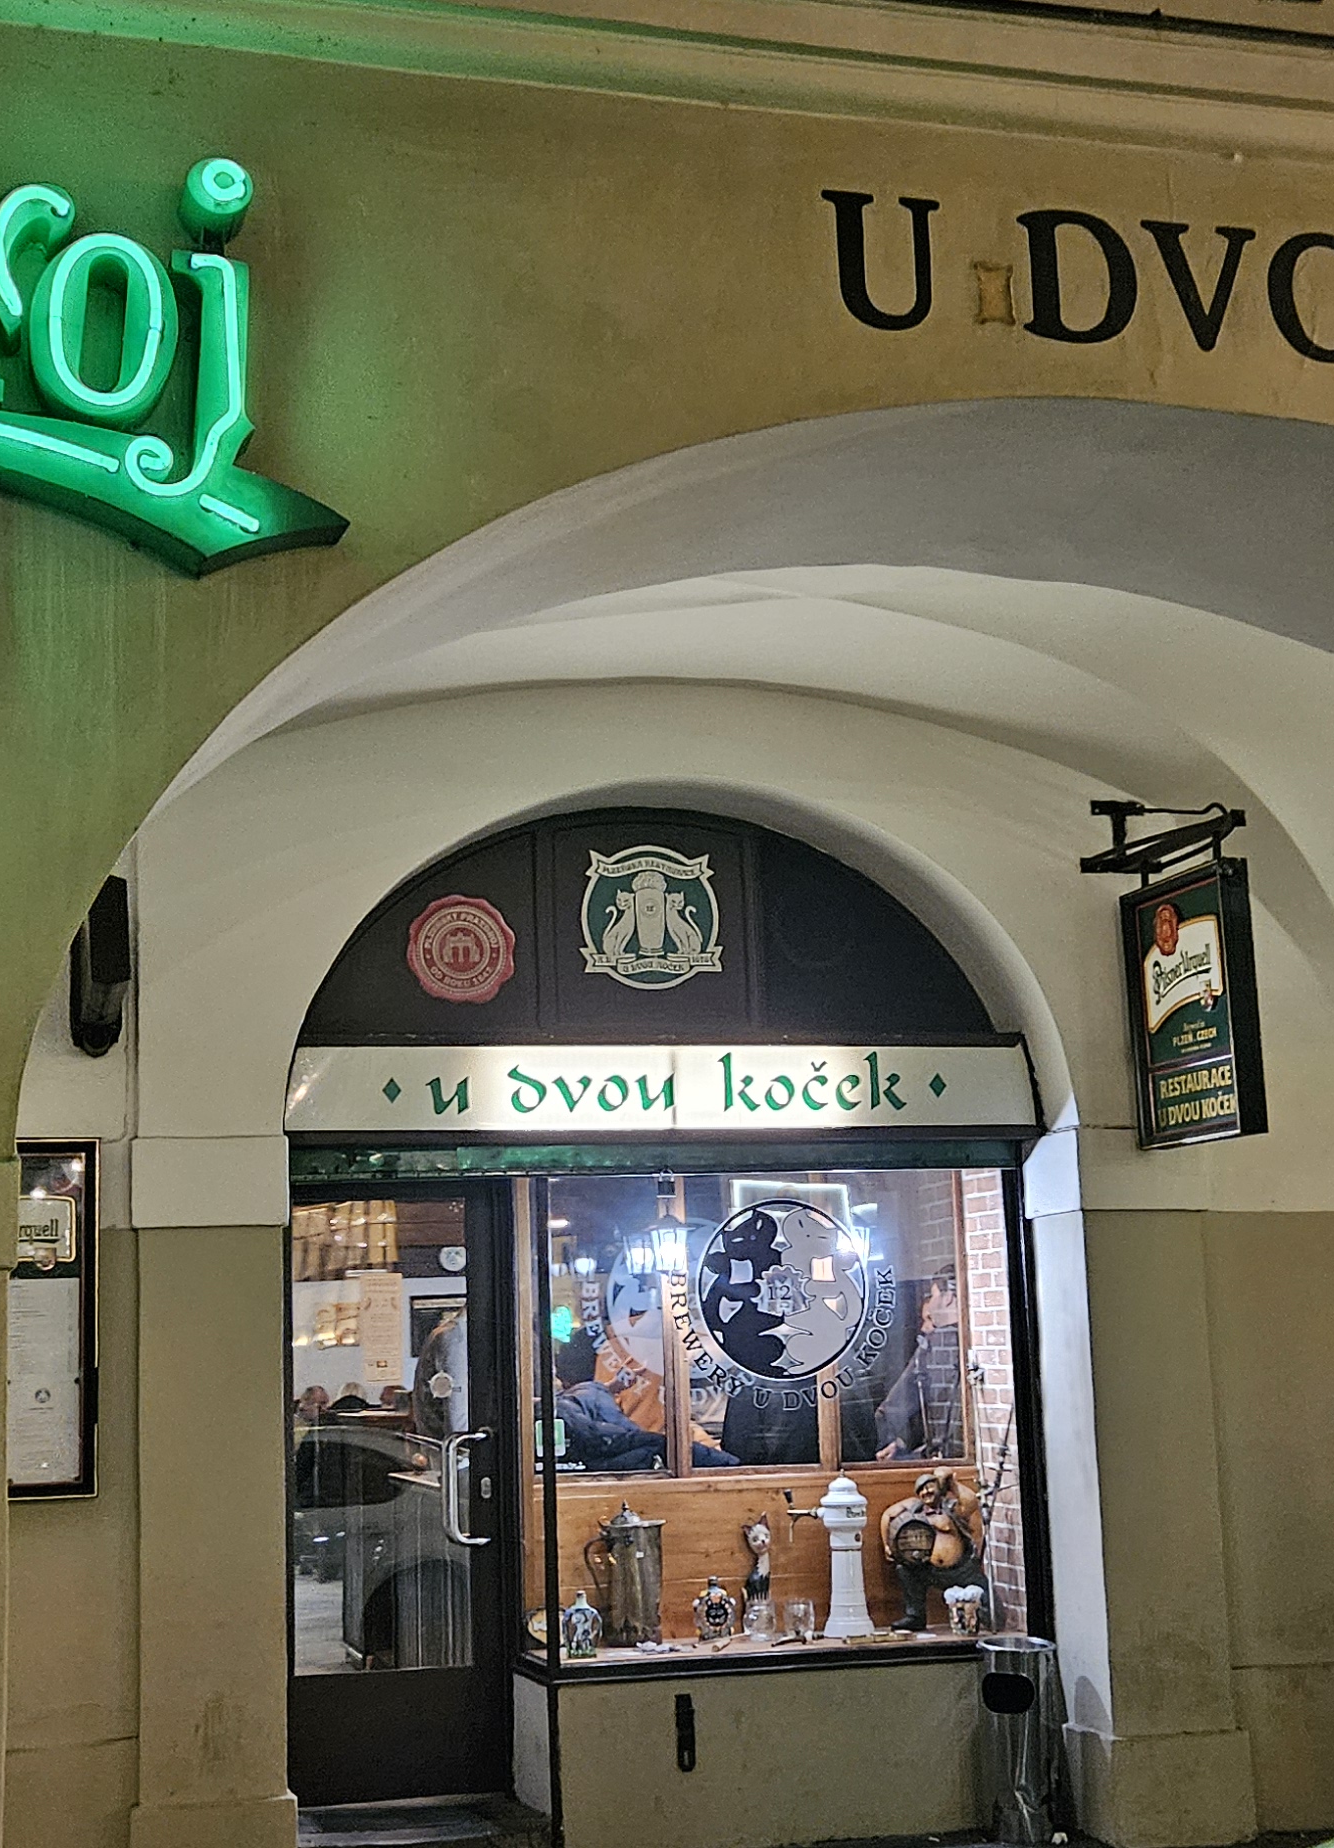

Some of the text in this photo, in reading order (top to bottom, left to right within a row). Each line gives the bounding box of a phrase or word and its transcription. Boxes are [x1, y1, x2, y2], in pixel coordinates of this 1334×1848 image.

[822, 189, 940, 332] U
[425, 1051, 908, 1117] u dvou koček
[1160, 1064, 1233, 1099] RESTAURACE
[1167, 1099, 1201, 1126] DVOU
[767, 1284, 792, 1301] 12
[669, 1264, 897, 1411] BREWERY U DVOU KOČEK
